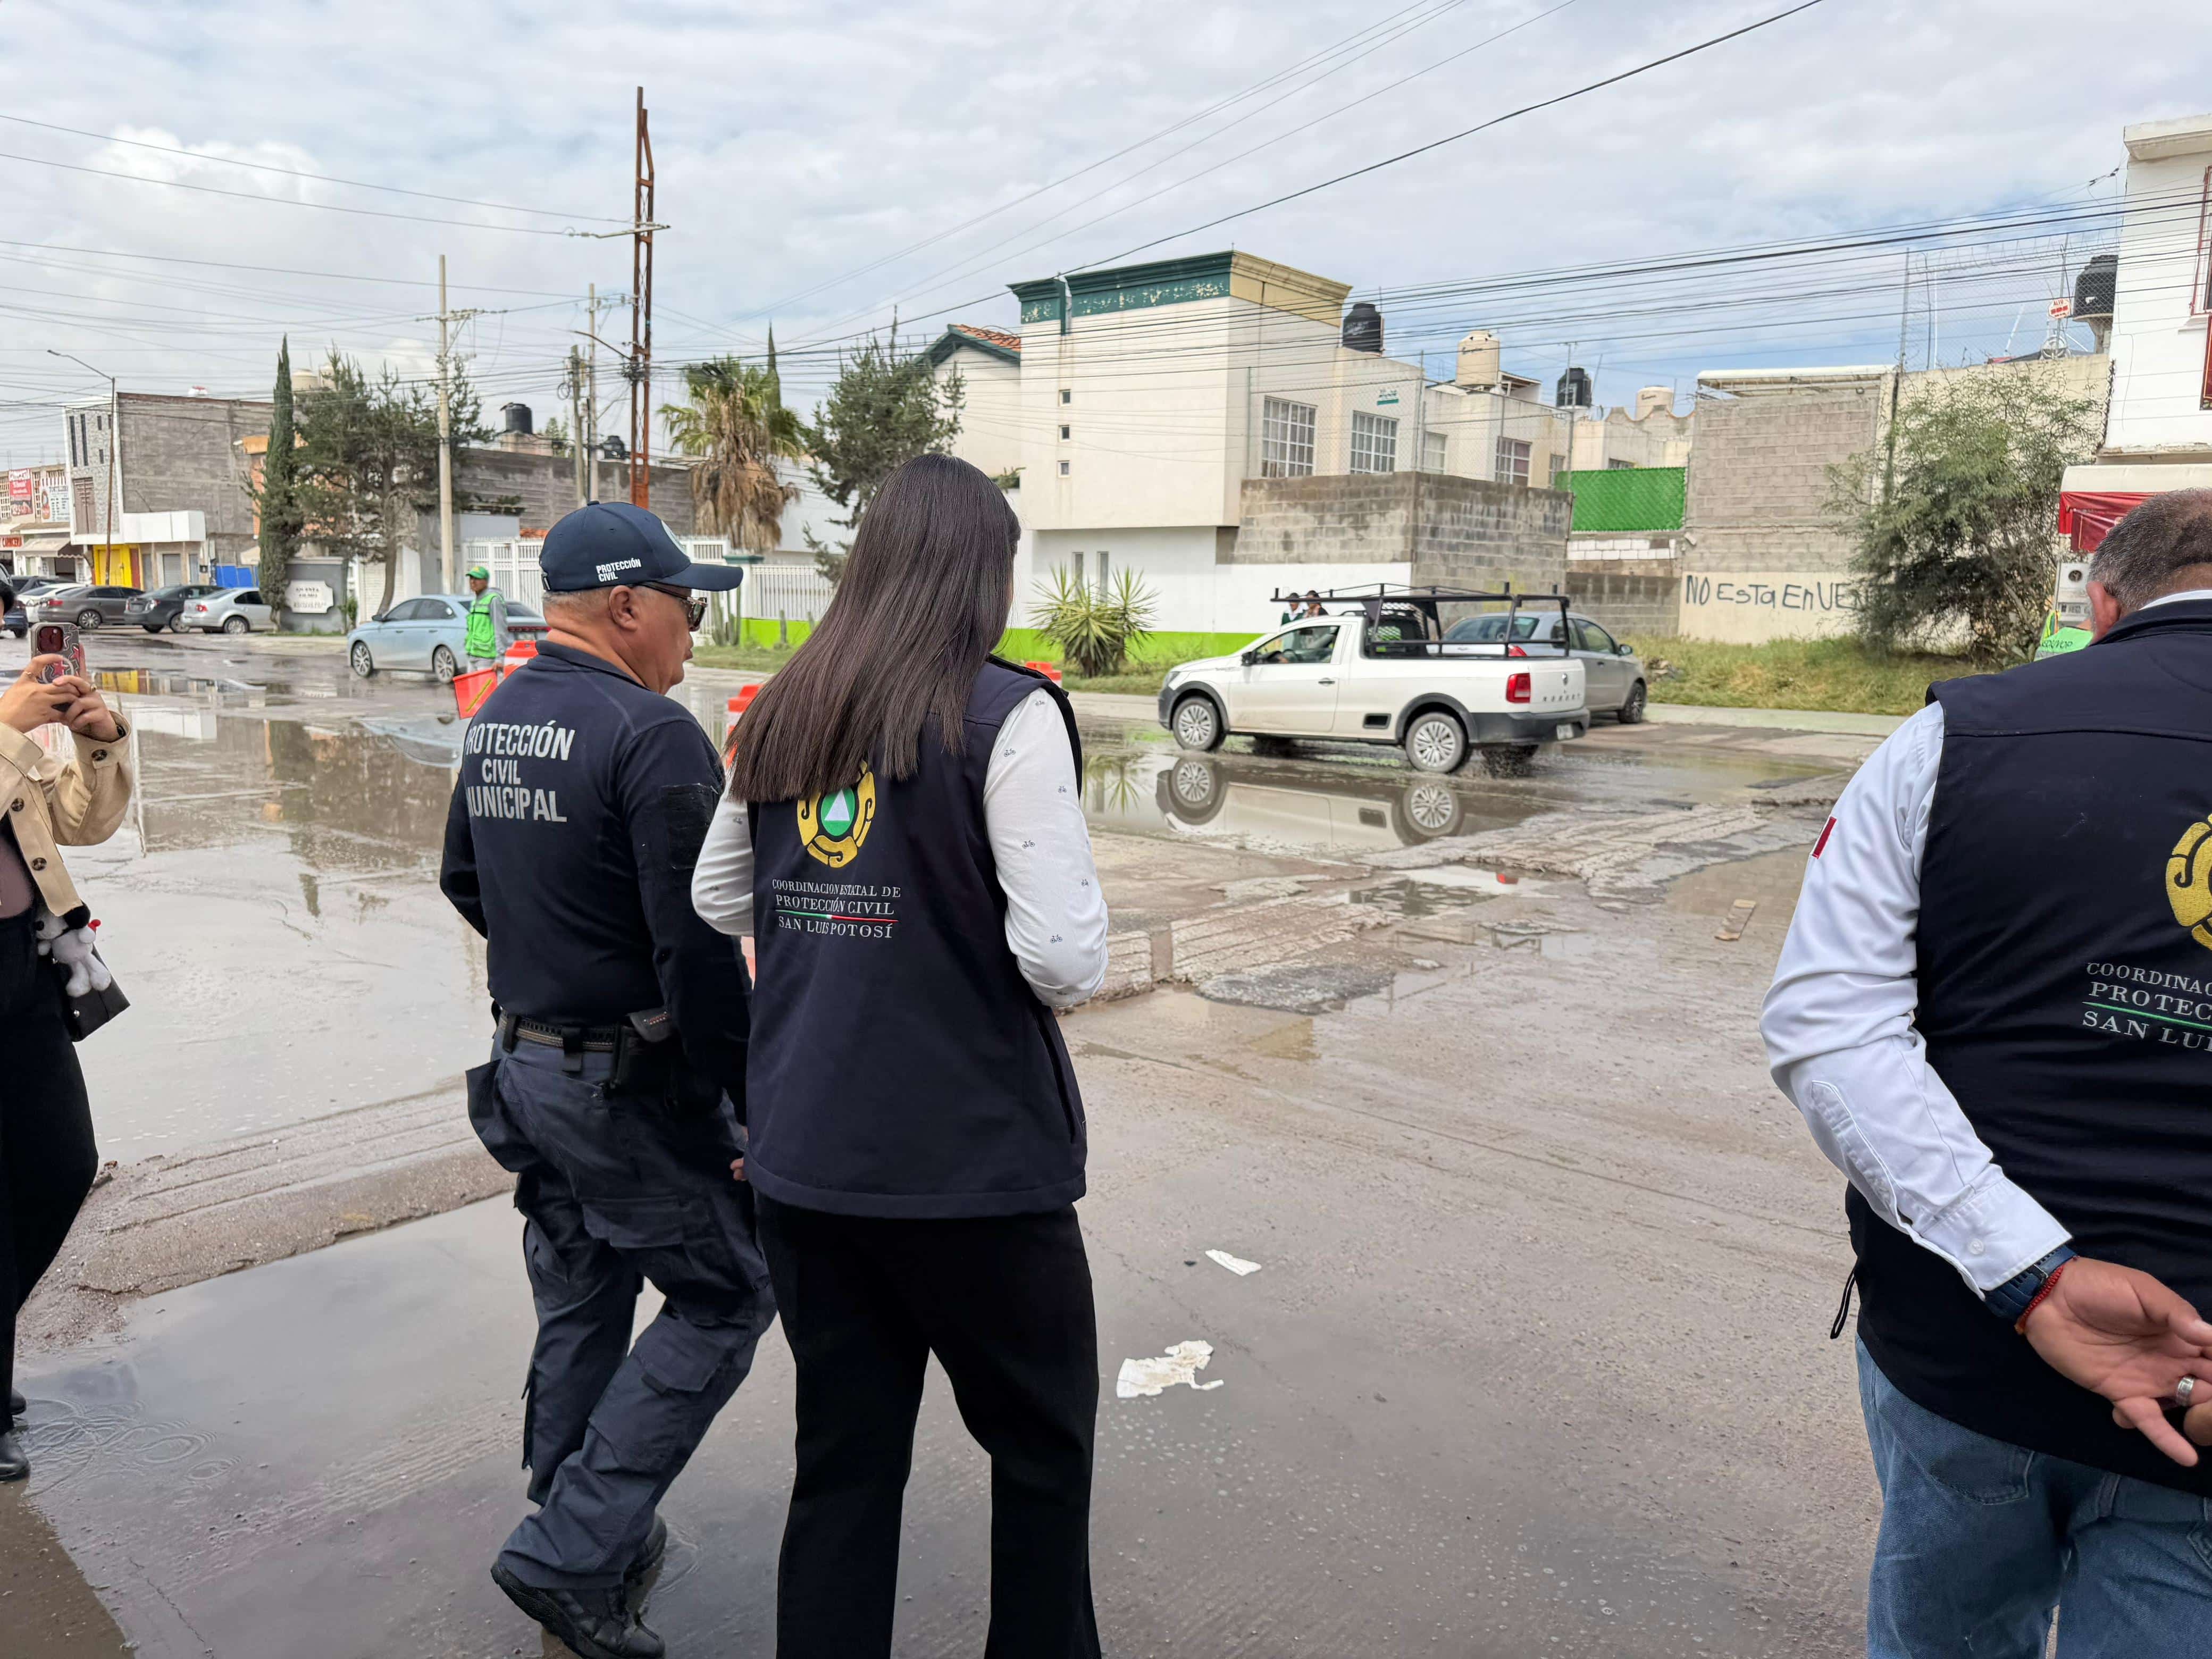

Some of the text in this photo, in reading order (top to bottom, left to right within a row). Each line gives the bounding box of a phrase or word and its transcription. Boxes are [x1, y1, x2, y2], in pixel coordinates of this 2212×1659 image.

[596, 557, 642, 574] PROTECCIÓN
[598, 572, 618, 582] CIVIL
[1686, 575, 1711, 606] NO
[482, 758, 521, 785] CIVIL
[839, 884, 877, 896] ESTATAL
[881, 886, 901, 898] DE
[776, 894, 895, 915] PROTECCIÓN CIVIL
[778, 916, 893, 939] SAN LUIS POTOSÍ
[2088, 982, 2212, 1021] PROTEC
[2082, 1011, 2149, 1040] SAN
